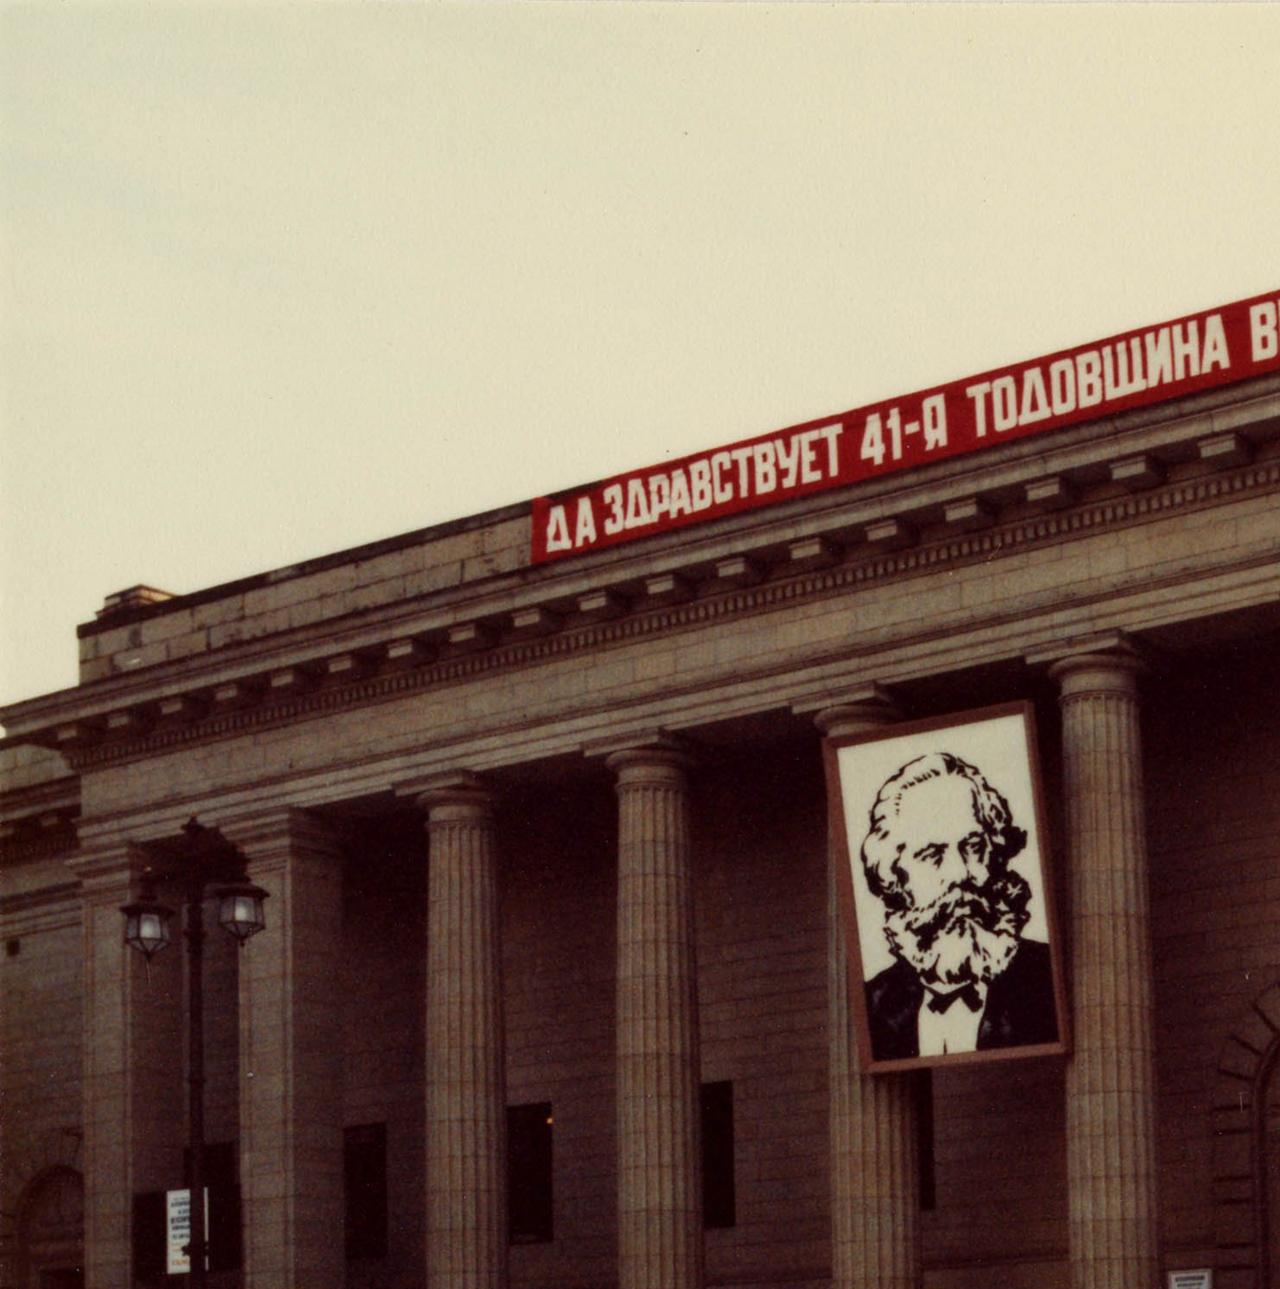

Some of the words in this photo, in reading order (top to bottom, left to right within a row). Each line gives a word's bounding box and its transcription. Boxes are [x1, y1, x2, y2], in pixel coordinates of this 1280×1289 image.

[546, 496, 597, 553] ДА
[603, 423, 843, 536] ЗДРАВСТВУЕТ
[860, 393, 948, 466] 41-Я
